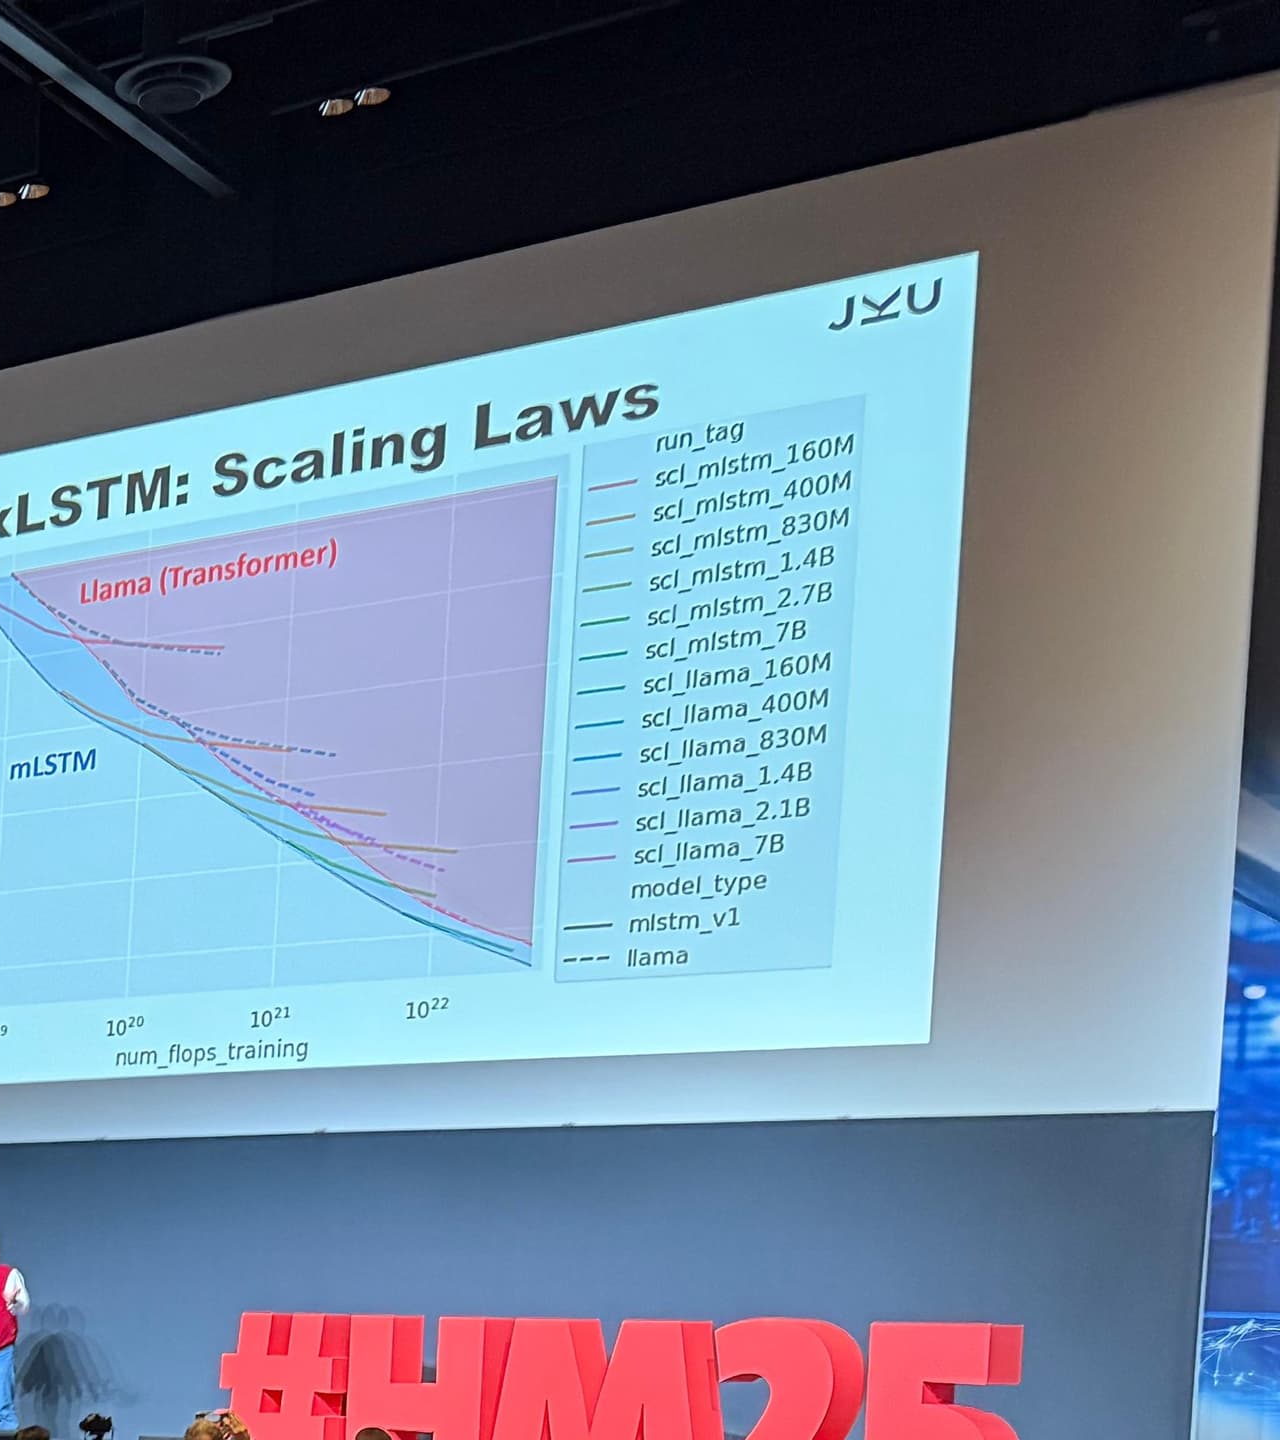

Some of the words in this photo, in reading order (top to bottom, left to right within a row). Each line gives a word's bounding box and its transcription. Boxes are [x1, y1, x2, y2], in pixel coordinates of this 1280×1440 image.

[212, 422, 447, 499] Scaling
[473, 382, 661, 451] Laws
[656, 421, 744, 453] run_tag
[655, 433, 855, 489] scl_mlstm_160M
[653, 470, 852, 524] scl_mlstm_400M
[651, 506, 850, 559] scl_mlstm_830M
[80, 572, 153, 605] Llama
[159, 537, 338, 598] (Transformer)
[649, 545, 835, 594] scl_mlstm_1.4B
[647, 581, 833, 629] scl_mlstm_2.7B
[645, 620, 807, 662] scl_mlstm_7B
[643, 652, 832, 697] scl_llama_160M
[641, 688, 830, 732] scl_llama_400M
[9, 748, 96, 780] mLSTM
[640, 723, 828, 766] scl_llama_830M
[637, 761, 813, 801] scl_llama_1.4B
[635, 797, 811, 835] scl_llama_2.1B
[634, 833, 785, 868] scl_llama_7B
[631, 873, 768, 900] model_type
[629, 907, 740, 934] mlstm_v1
[627, 948, 689, 968] llama
[116, 1038, 309, 1070] num_flops_training
